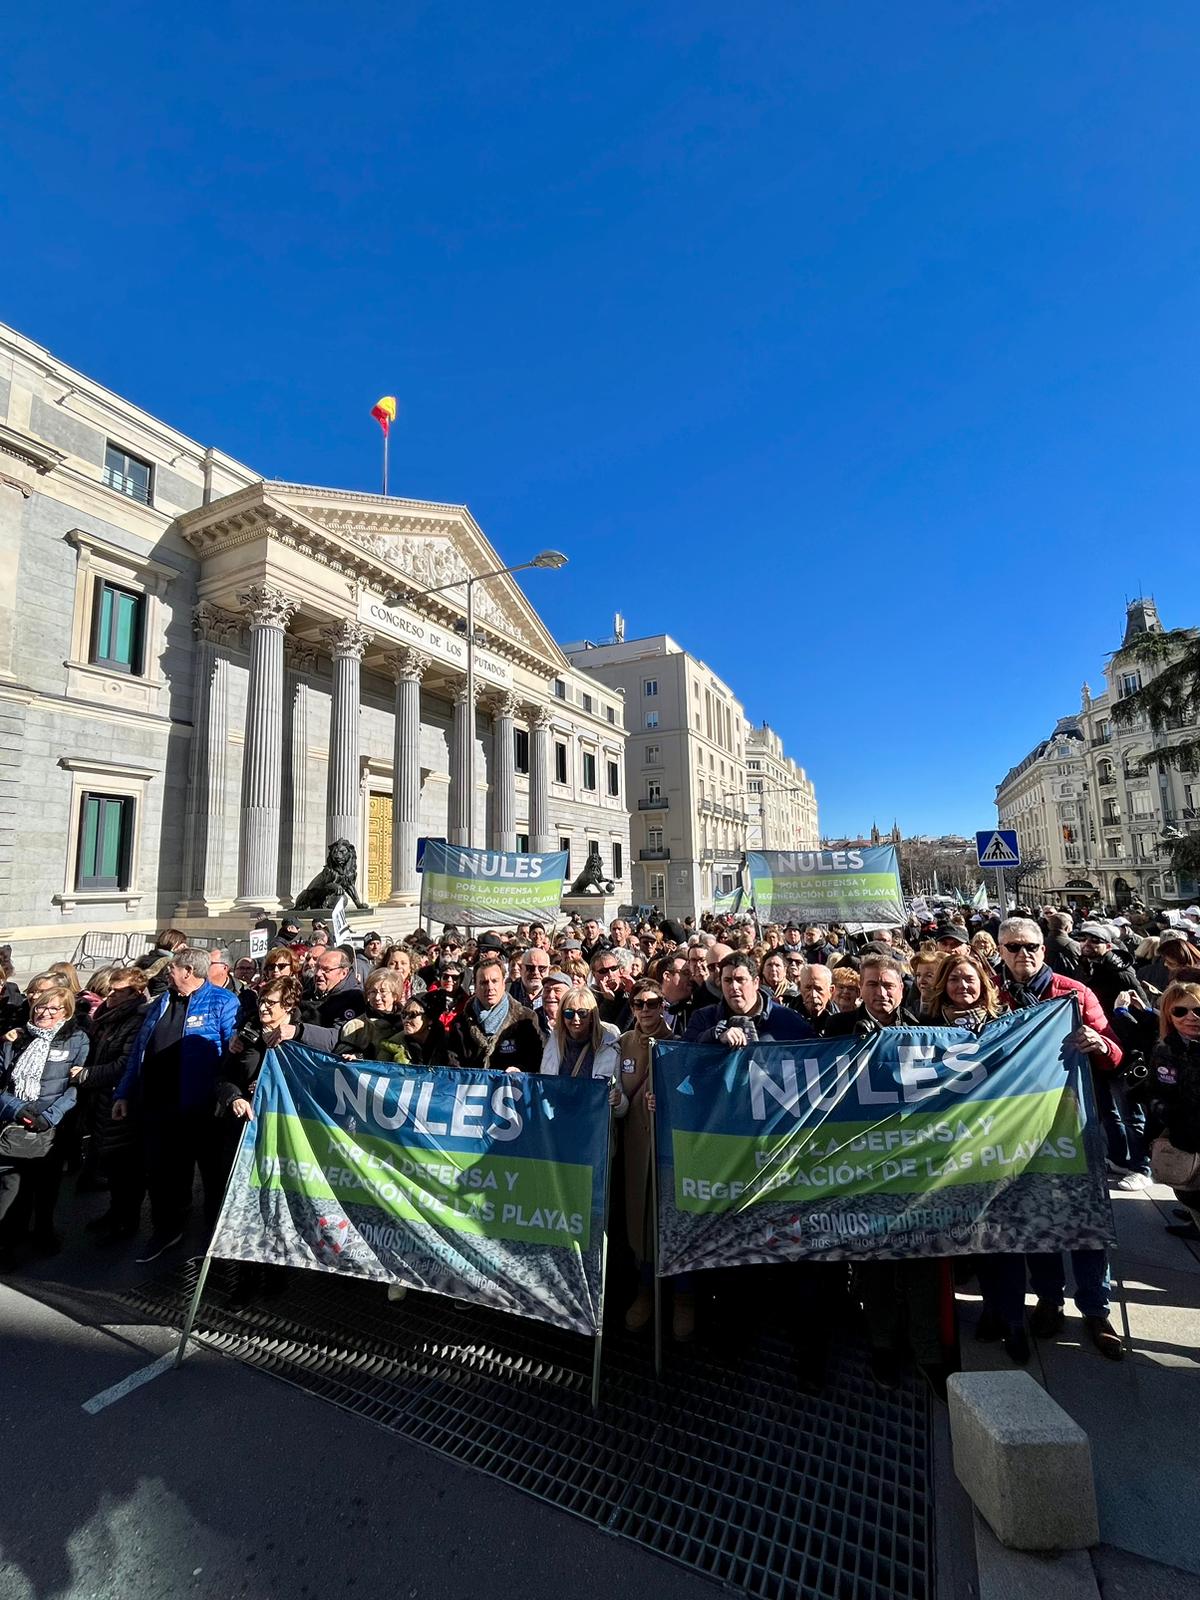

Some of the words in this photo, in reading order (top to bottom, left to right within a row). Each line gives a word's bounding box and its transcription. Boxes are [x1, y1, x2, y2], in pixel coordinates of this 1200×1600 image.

[370, 604, 425, 639] CONGRESO
[429, 633, 441, 648] DE
[446, 641, 462, 658] LOS
[473, 655, 506, 678] PUTADOS
[458, 852, 544, 879] NULES
[777, 850, 865, 873] NULES
[455, 882, 476, 892] POR
[478, 885, 491, 893] LA
[493, 886, 533, 895] DEFENSA
[534, 886, 541, 894] Y
[501, 896, 513, 905] DE
[515, 897, 531, 905] LAS
[779, 880, 799, 889] POR
[800, 880, 813, 888] LA
[815, 878, 860, 888] DEFENSA
[859, 878, 867, 886] Y
[827, 889, 839, 899] DE
[842, 887, 861, 898] LAS
[862, 885, 897, 897] PLAYAS
[748, 1042, 988, 1121] NULES
[333, 1066, 524, 1142] NULES
[810, 1136, 840, 1157] LA
[850, 1119, 974, 1153] DEFENSA
[977, 1115, 995, 1136] Y
[367, 1151, 395, 1172] LA
[401, 1158, 498, 1190] DEFENSA
[504, 1170, 519, 1191] Y
[882, 1157, 918, 1181] DE
[926, 1151, 974, 1178] LAS
[980, 1135, 1077, 1167] PLAYAS
[260, 1155, 415, 1204] REGENERAIÓN
[453, 1198, 496, 1222] LAS
[502, 1203, 584, 1235] PLAYAS
